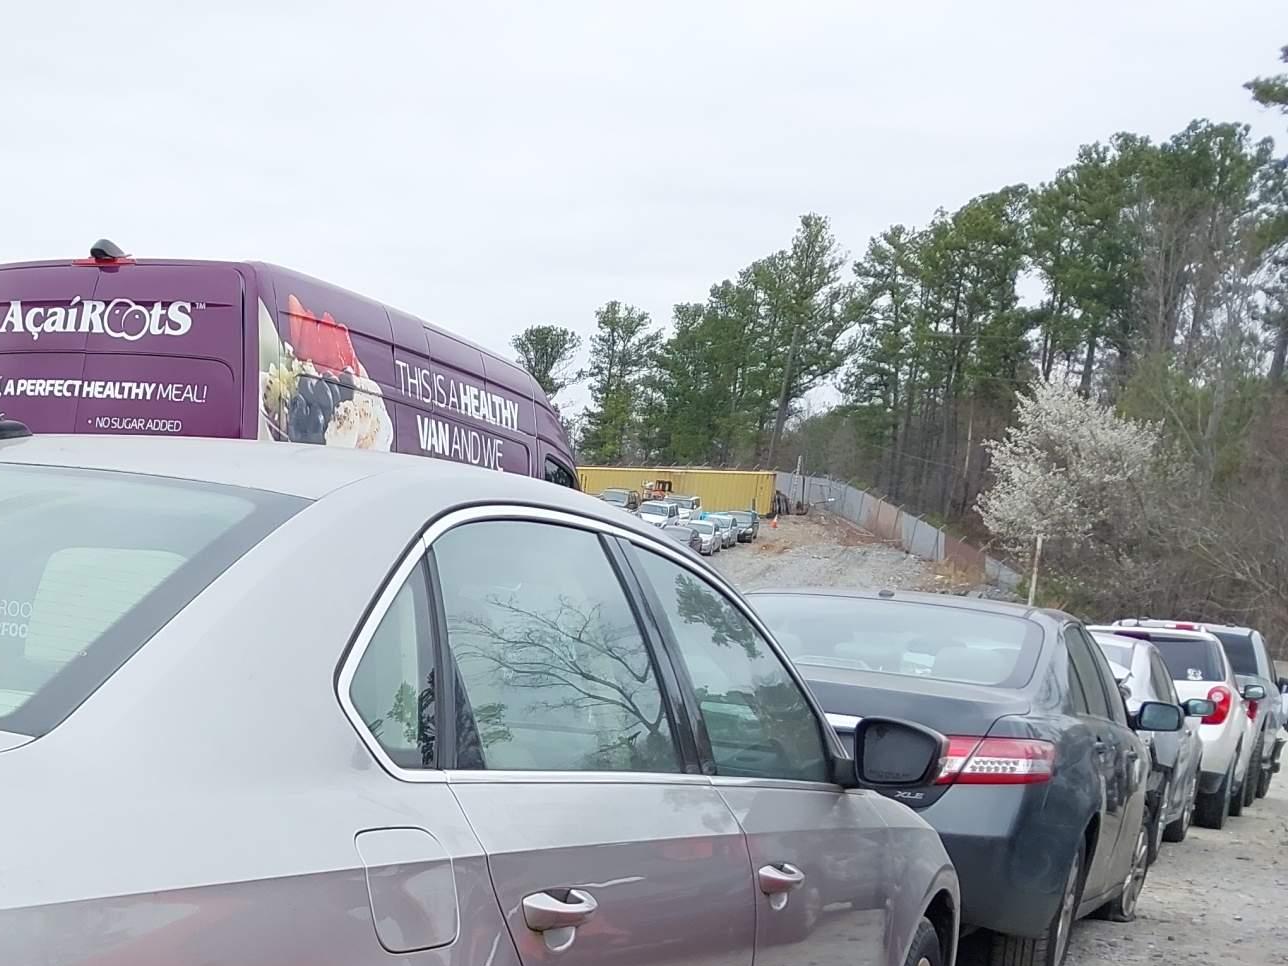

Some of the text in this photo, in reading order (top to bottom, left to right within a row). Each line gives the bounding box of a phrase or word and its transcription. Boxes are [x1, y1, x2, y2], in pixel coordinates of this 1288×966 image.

[3, 380, 15, 396] A
[16, 379, 82, 398] PERFECT
[82, 382, 156, 400] HEALTHY
[156, 383, 208, 403] MEAL!
[395, 359, 432, 403] THIS
[448, 380, 460, 414] A
[459, 382, 519, 431] HEALTHY
[95, 416, 182, 432] NO SUGAR ADDED
[416, 414, 504, 472] VAN AND WE
